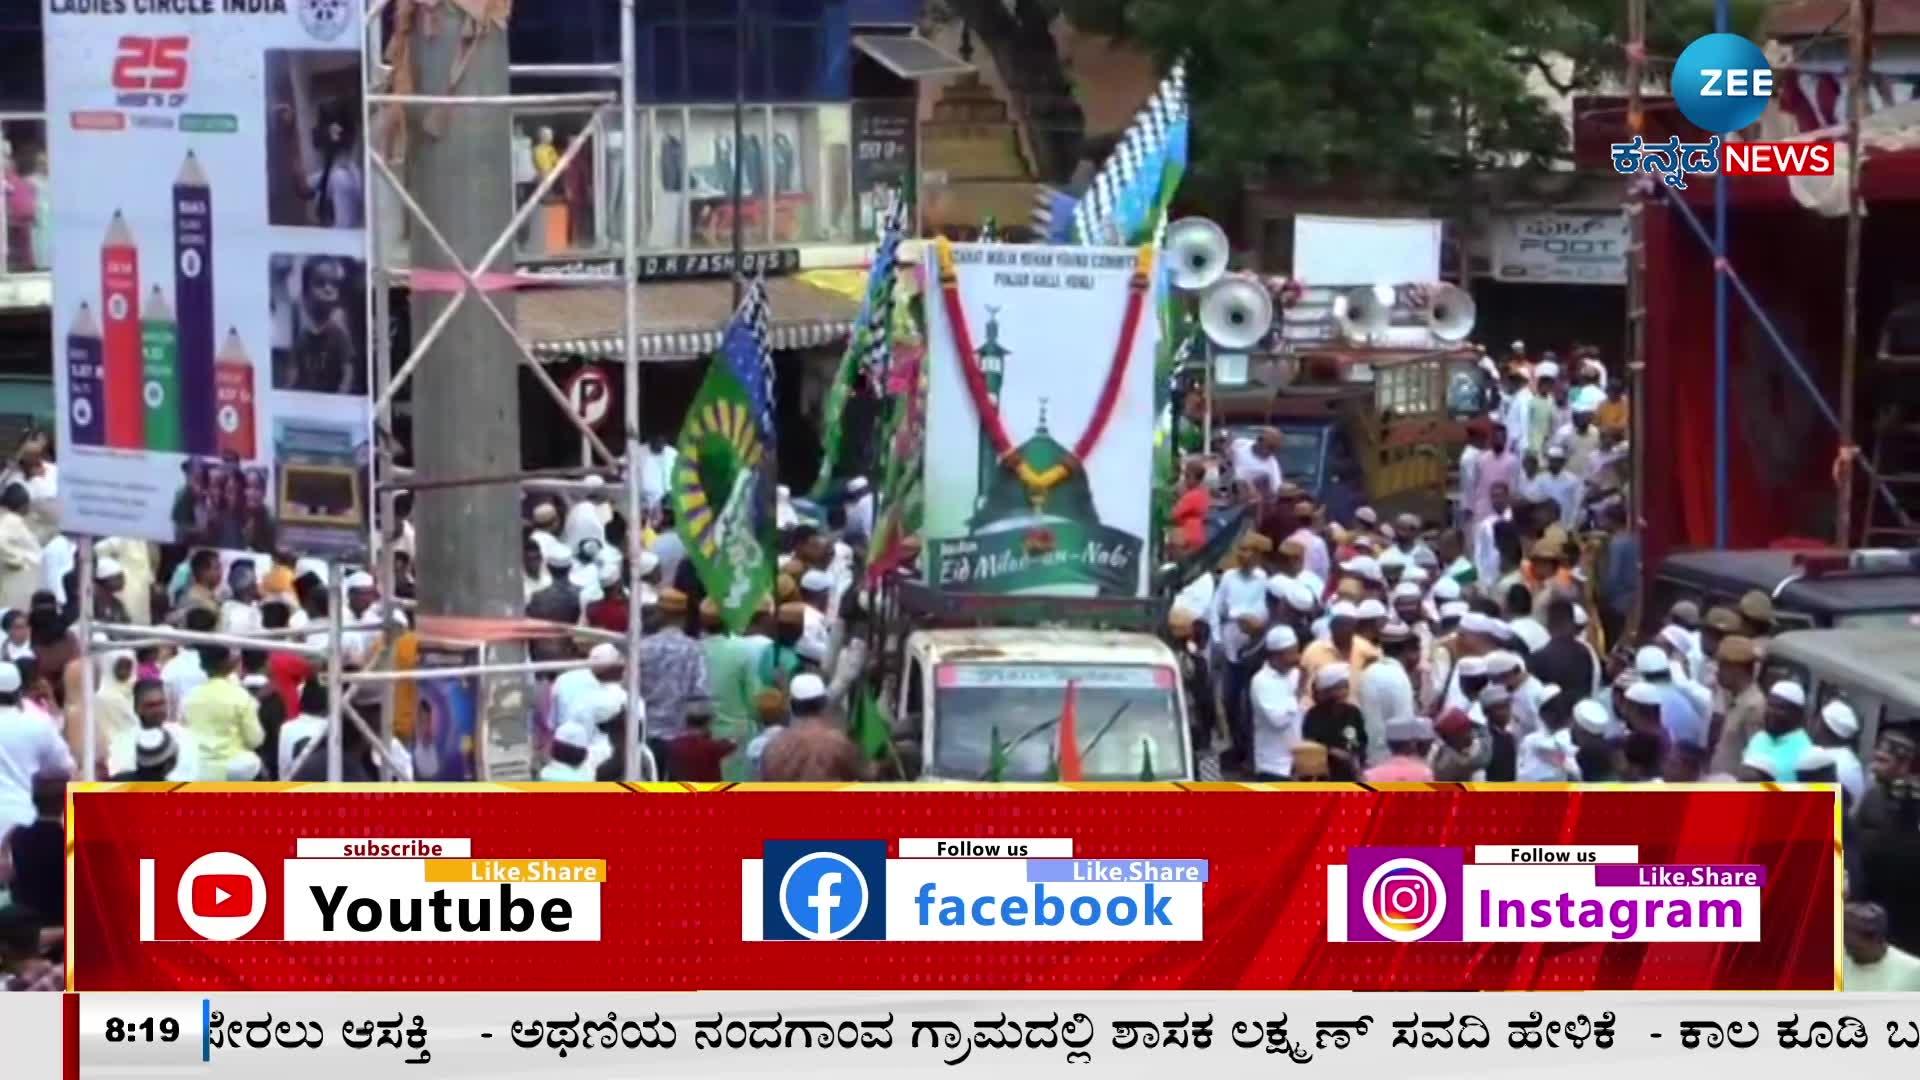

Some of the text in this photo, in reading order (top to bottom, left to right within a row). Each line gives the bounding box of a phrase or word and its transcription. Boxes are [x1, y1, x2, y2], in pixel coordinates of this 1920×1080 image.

[49, 0, 287, 14] LADIES CIRCLE INDIA
[112, 36, 189, 90] 25
[685, 252, 780, 273] FASHONS
